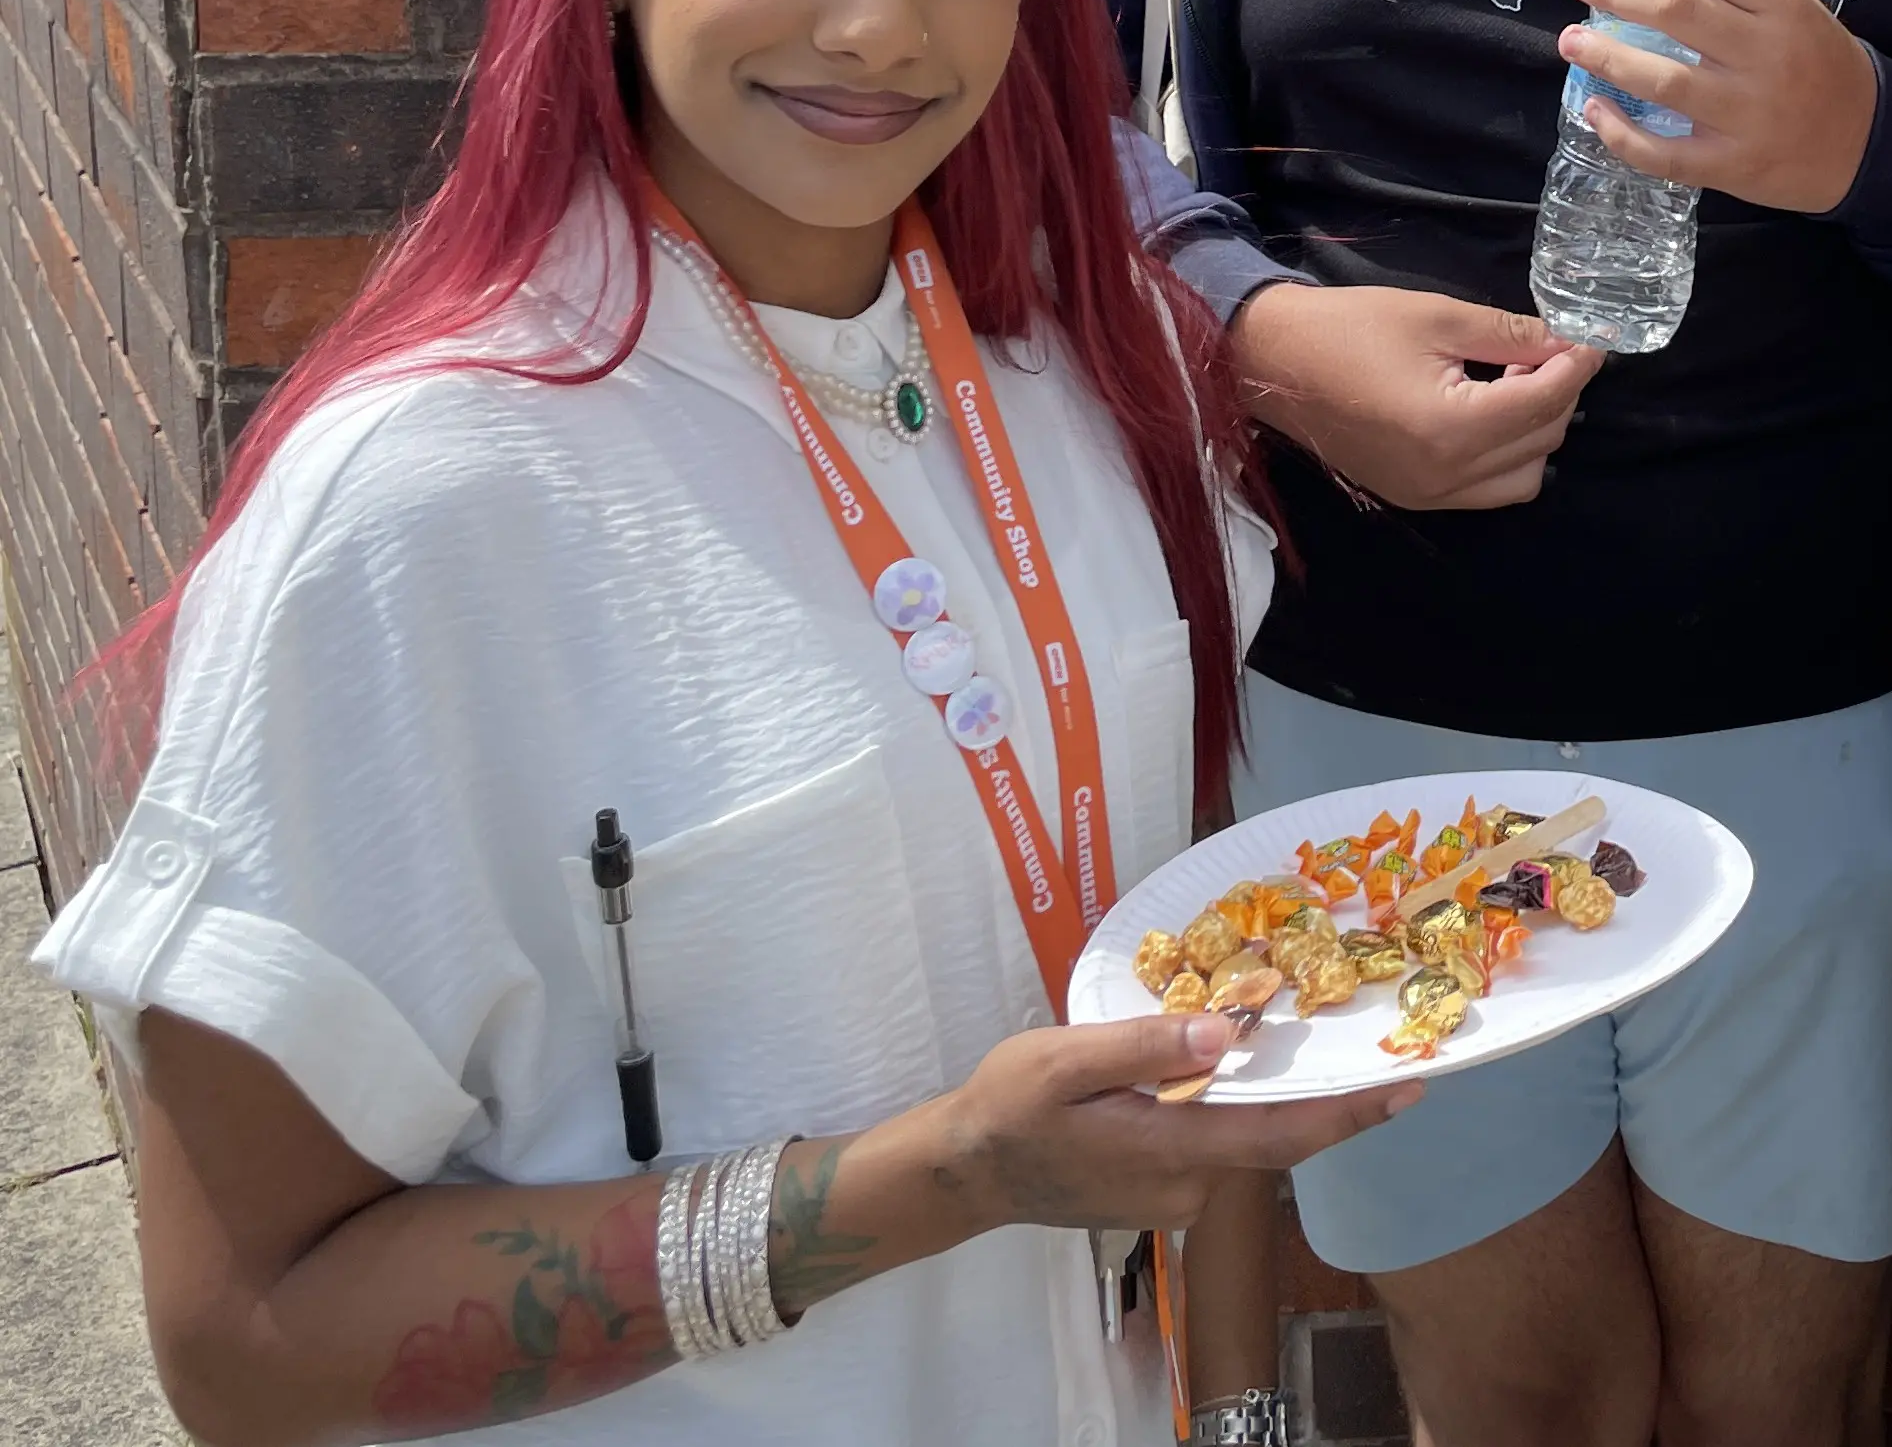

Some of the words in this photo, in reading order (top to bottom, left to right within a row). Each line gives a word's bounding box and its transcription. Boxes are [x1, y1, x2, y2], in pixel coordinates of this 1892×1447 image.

[955, 379, 1016, 522] Community
[1005, 525, 1040, 588] Shop
[991, 769, 1054, 914] Community
